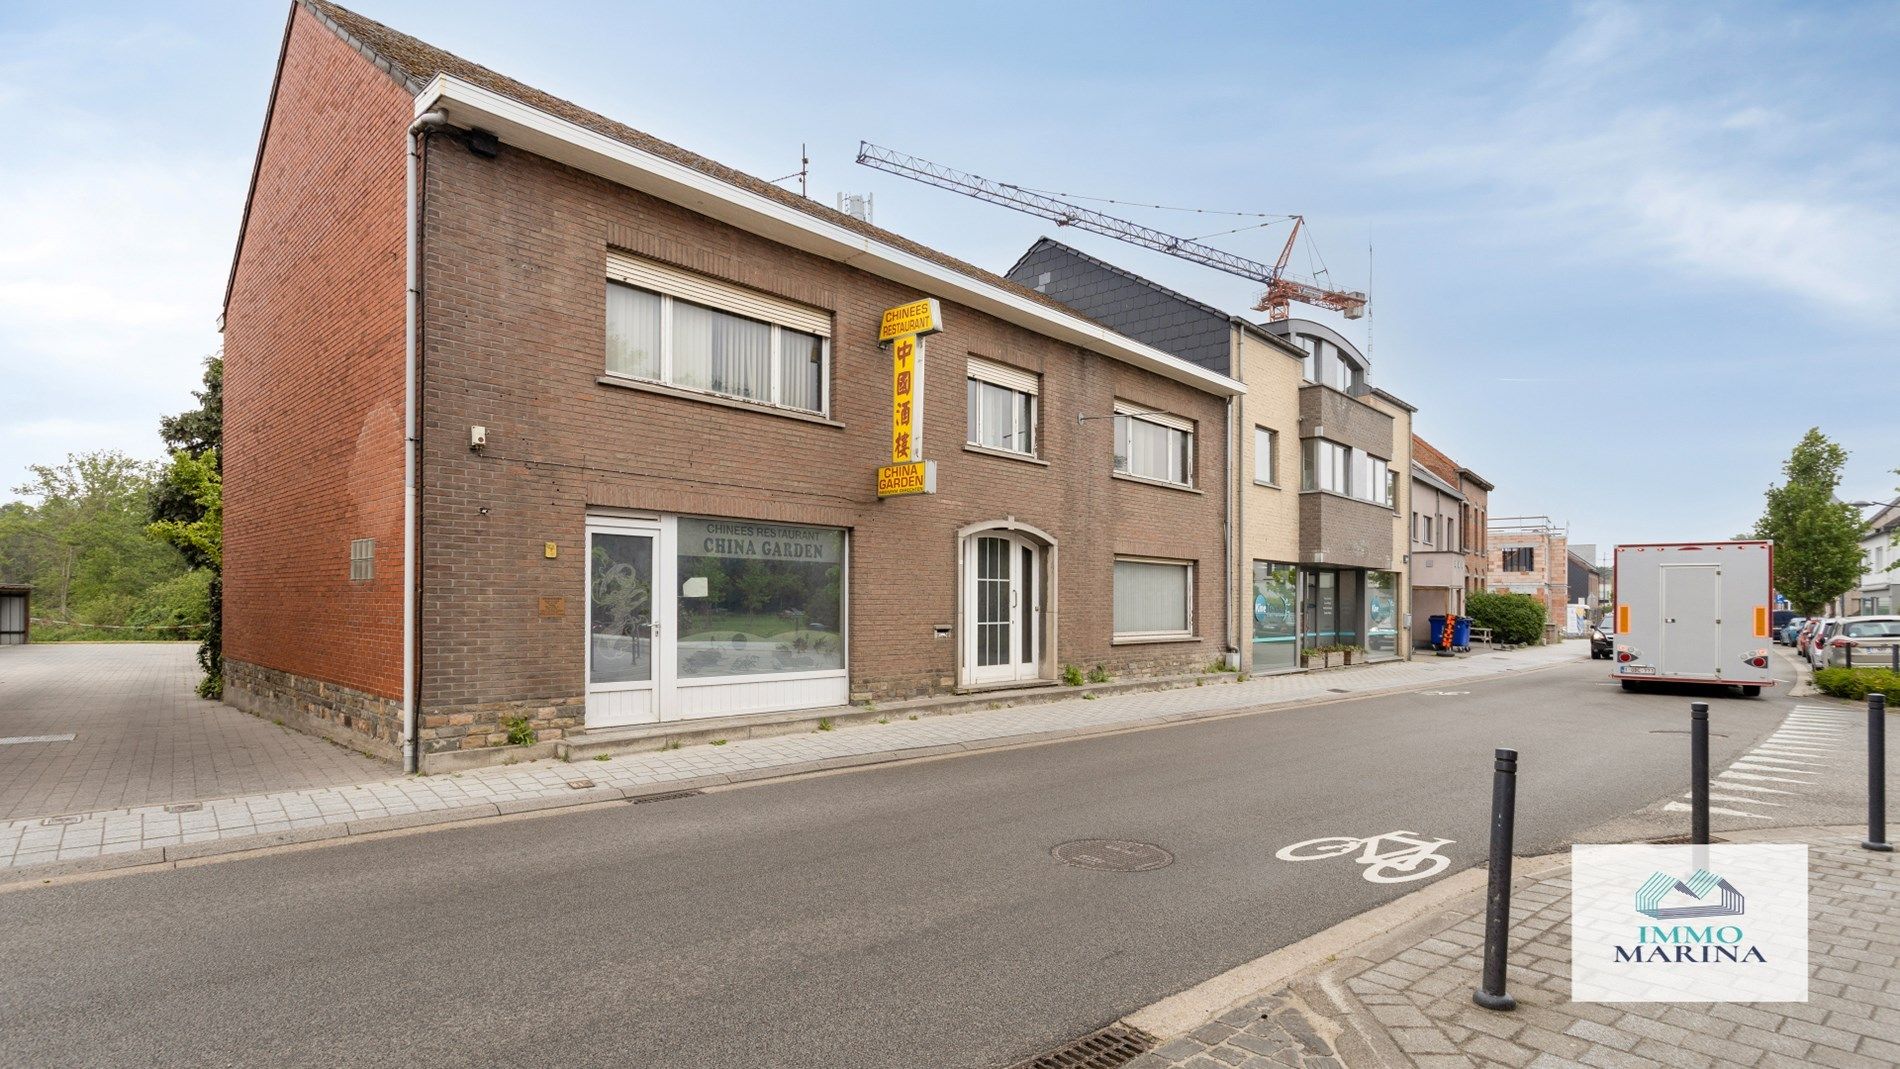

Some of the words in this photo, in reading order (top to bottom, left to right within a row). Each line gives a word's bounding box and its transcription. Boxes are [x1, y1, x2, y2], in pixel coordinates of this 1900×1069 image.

[885, 303, 928, 323] CHINEES
[883, 315, 930, 337] RESTAURANT
[884, 464, 918, 478] CHINA
[879, 475, 924, 490] GARDEN
[706, 523, 754, 537] CHINEES
[756, 527, 820, 540] RESTAURANT
[703, 537, 757, 555] CHINA
[761, 541, 823, 559] GARDEN
